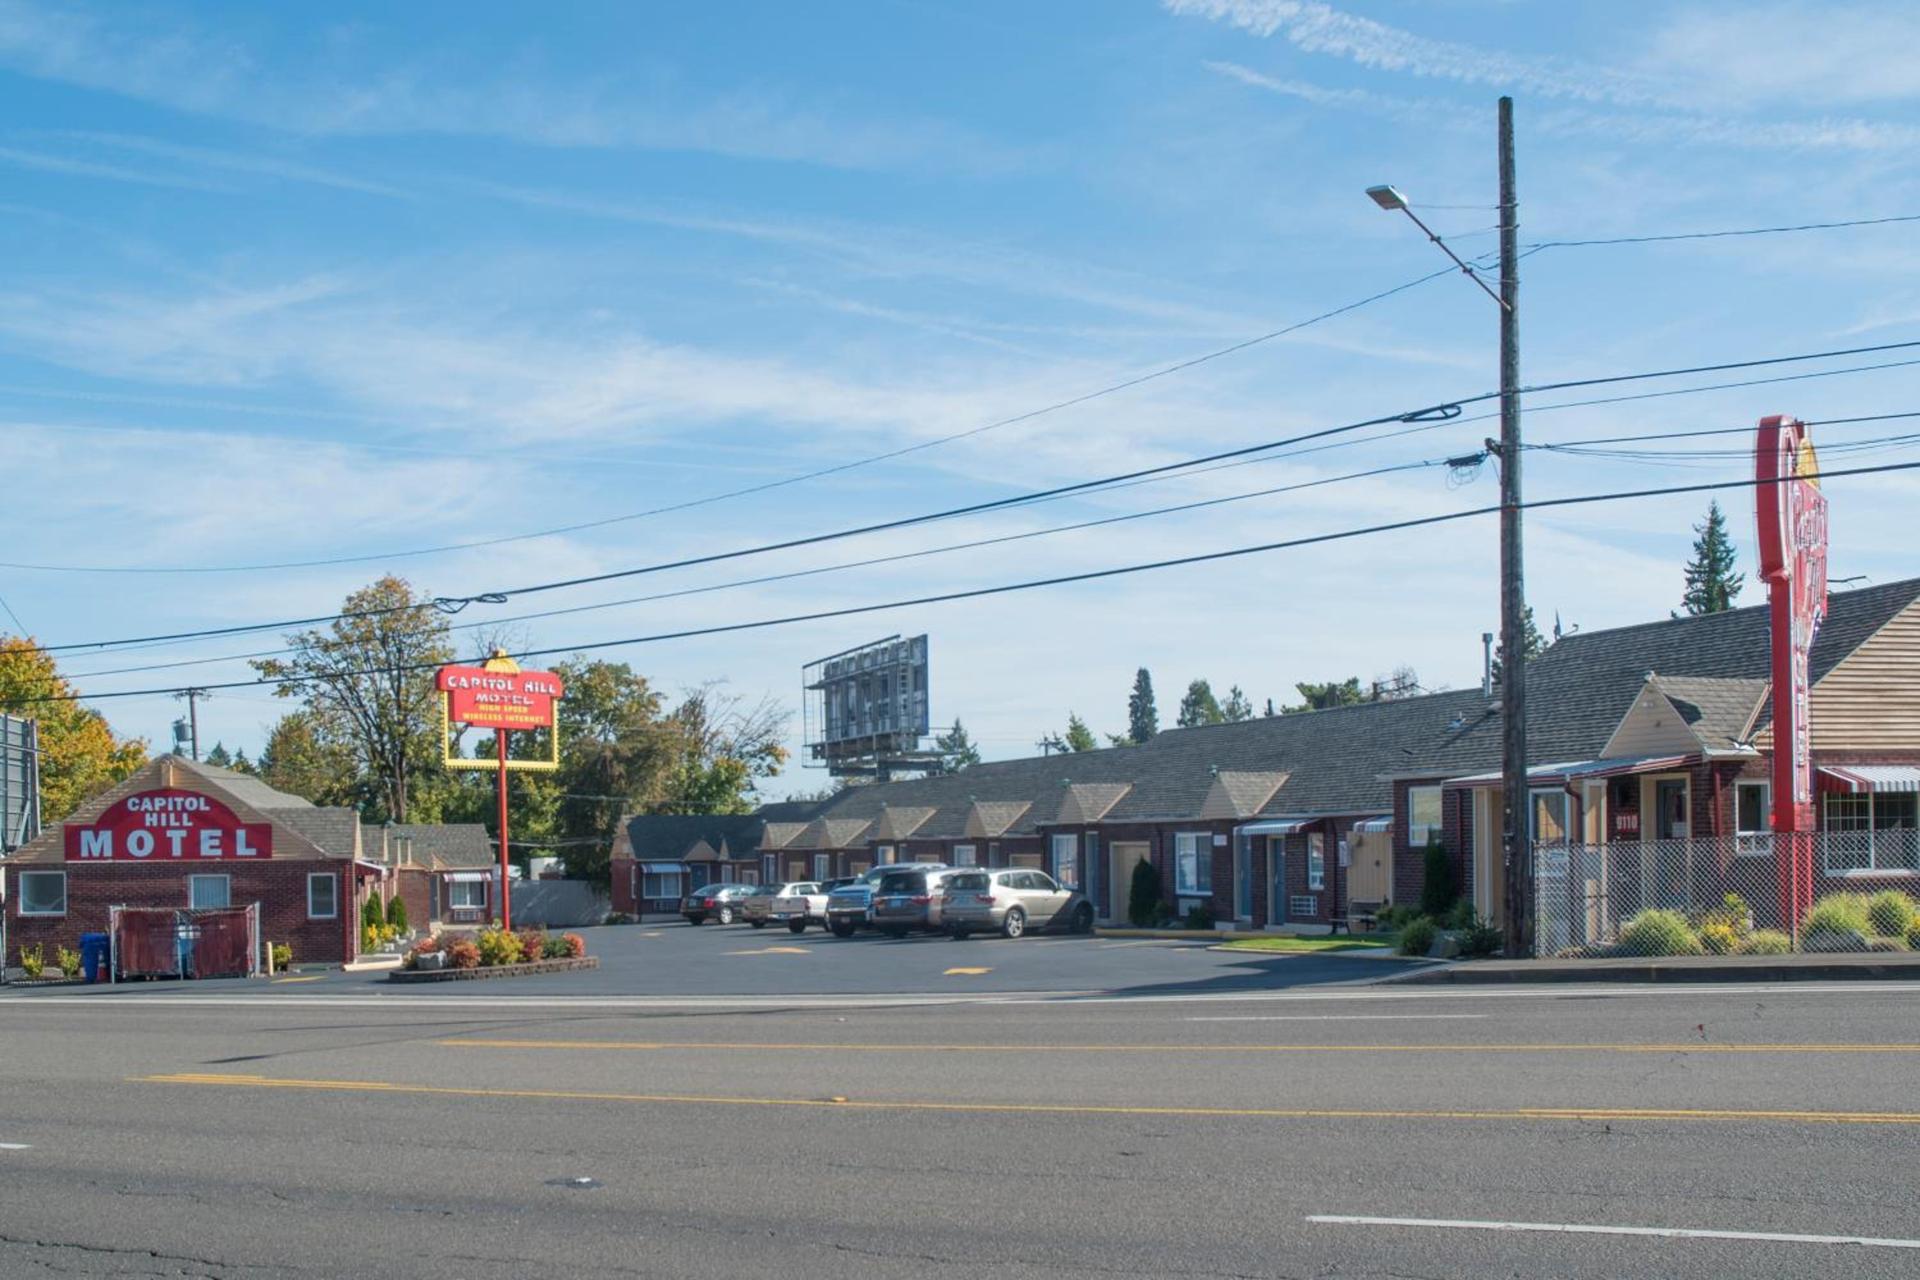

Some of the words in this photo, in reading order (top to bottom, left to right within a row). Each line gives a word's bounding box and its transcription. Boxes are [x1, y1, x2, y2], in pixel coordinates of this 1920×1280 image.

[447, 676, 515, 691] CAPITOL
[524, 680, 556, 694] HILL
[476, 693, 534, 705] MOTEL
[127, 797, 211, 812] CAPITOL
[145, 812, 193, 827] HILL
[80, 829, 257, 858] MOTEL
